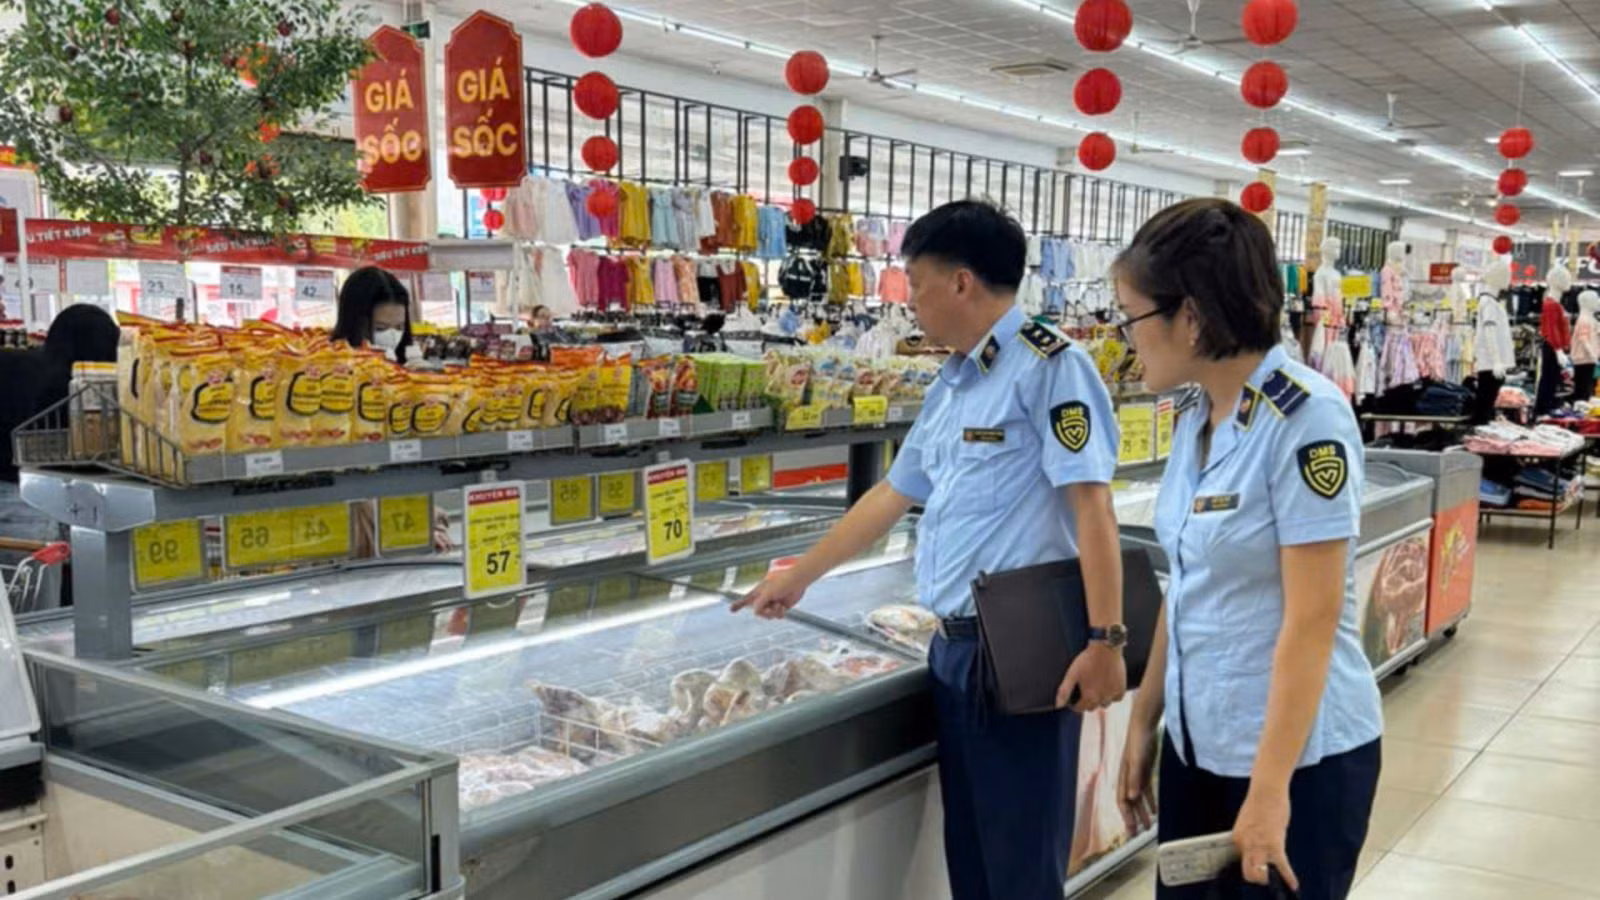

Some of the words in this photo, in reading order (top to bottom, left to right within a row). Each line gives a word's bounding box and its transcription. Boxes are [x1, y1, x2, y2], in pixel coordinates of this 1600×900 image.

[365, 68, 414, 113] GIÁ
[457, 56, 510, 103] GIÁ
[362, 117, 422, 166] SỐC
[453, 108, 518, 159] SỐC
[302, 286, 317, 299] 42
[664, 519, 683, 541] 70
[486, 550, 511, 575] 57
